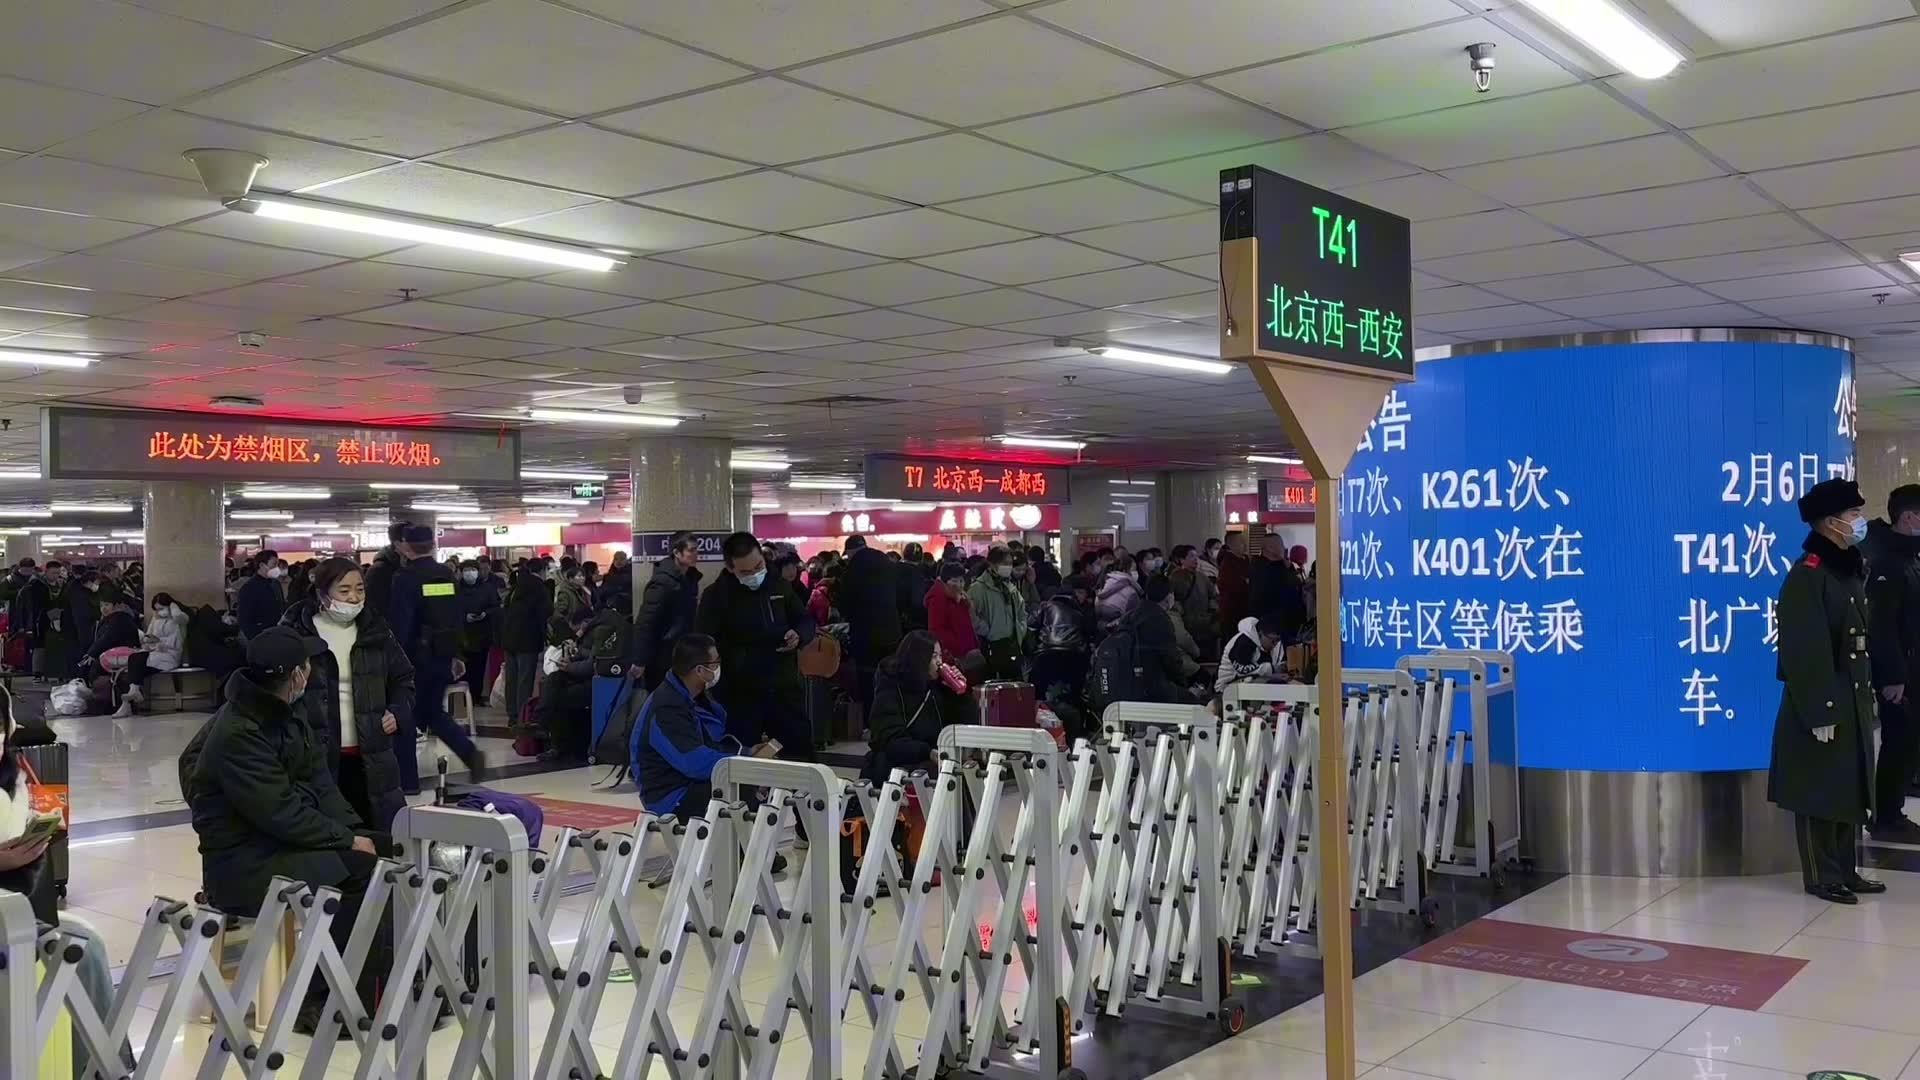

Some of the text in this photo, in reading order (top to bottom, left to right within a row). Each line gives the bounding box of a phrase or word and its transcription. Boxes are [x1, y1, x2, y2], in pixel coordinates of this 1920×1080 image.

[1312, 206, 1357, 267] T41
[1266, 283, 1403, 359] 北京西-西安
[905, 466, 923, 488] T7
[1285, 487, 1305, 504] K401
